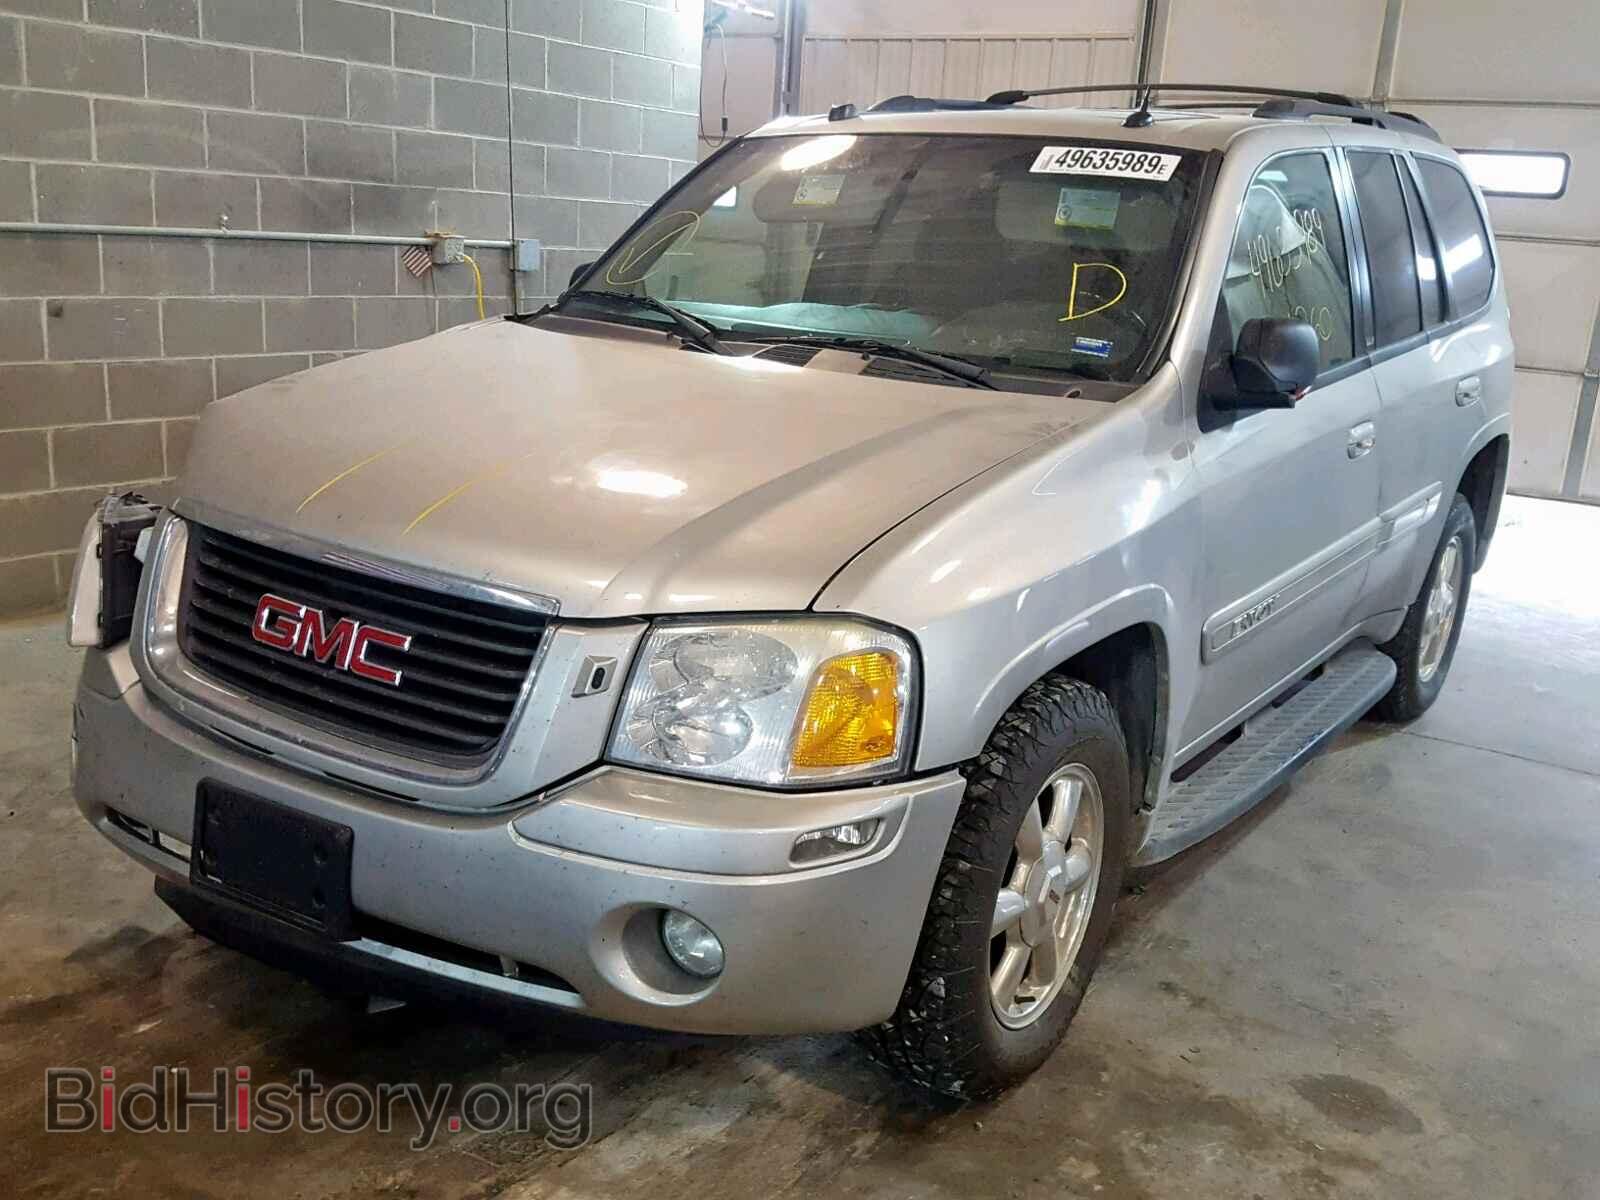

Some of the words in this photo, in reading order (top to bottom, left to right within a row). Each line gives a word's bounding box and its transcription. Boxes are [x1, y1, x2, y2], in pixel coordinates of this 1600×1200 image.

[1055, 149, 1161, 174] 49635989
[1157, 164, 1168, 175] E
[1058, 262, 1128, 323] D
[252, 593, 412, 687] GMC
